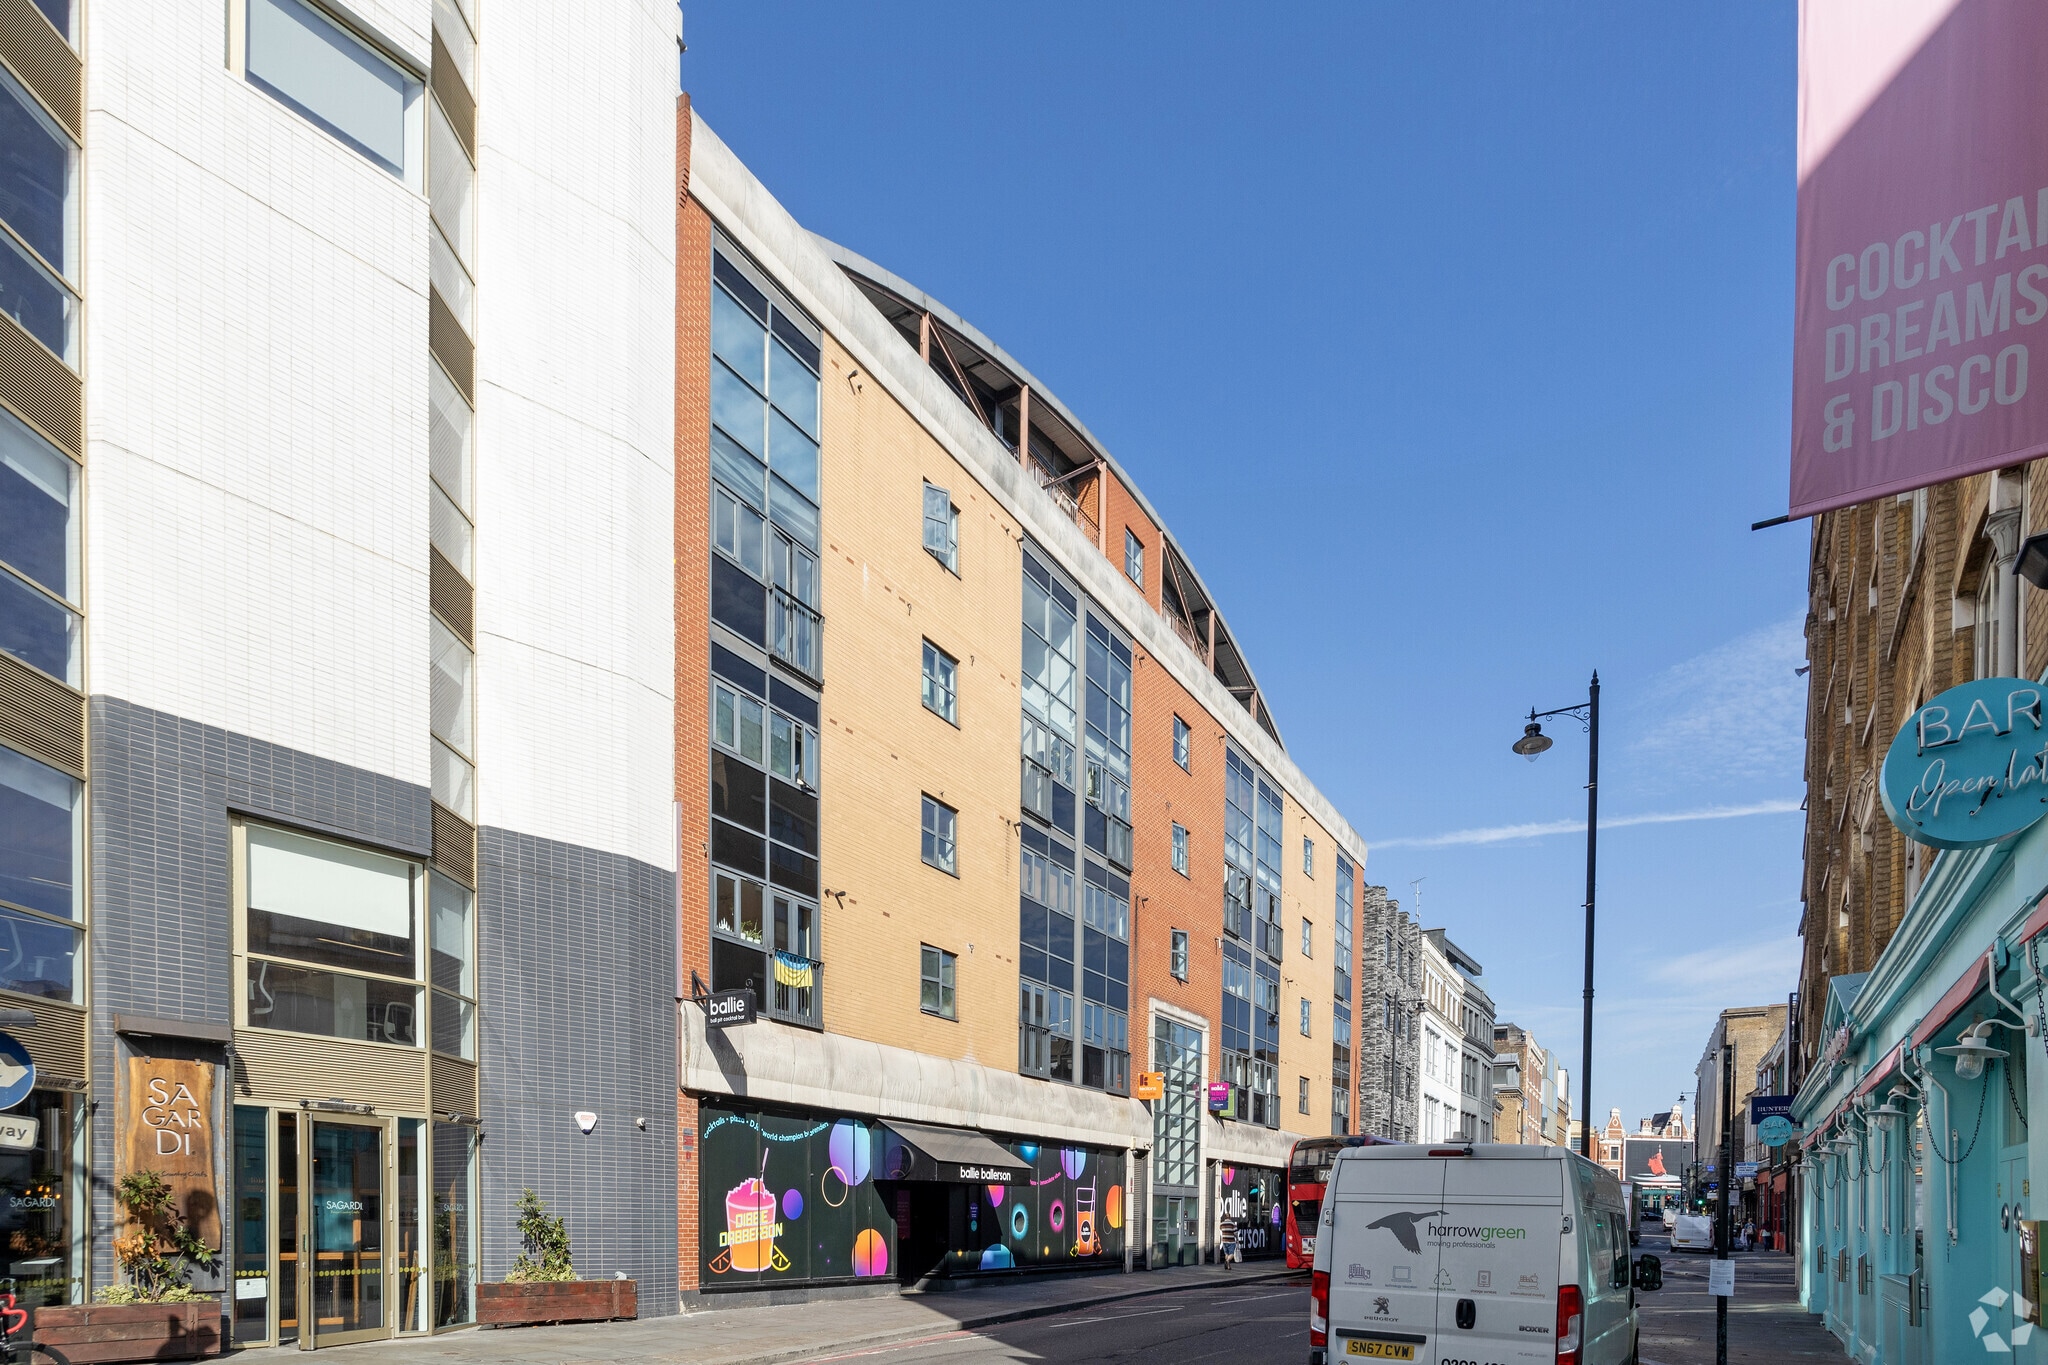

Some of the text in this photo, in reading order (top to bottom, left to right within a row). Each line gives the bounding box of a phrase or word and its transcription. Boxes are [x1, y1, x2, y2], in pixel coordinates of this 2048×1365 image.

[1824, 263, 2048, 384] DREAMS
[1822, 343, 2029, 454] & DISCO
[1918, 688, 2043, 749] BAR
[1908, 758, 1999, 817] Open
[709, 996, 746, 1016] ballie
[147, 1077, 199, 1107] SA
[142, 1106, 202, 1128] GAR
[155, 1128, 191, 1156] DI
[960, 1166, 1012, 1181] ballie ballerson
[10, 1196, 56, 1208] SAGARDI
[326, 1200, 364, 1211] SAGARDI
[1428, 1221, 1526, 1242] harrowgreen
[1427, 1240, 1496, 1249] moving professionals
[1518, 1325, 1550, 1334] BOXER
[1351, 1341, 1410, 1357] SN67 CVW
